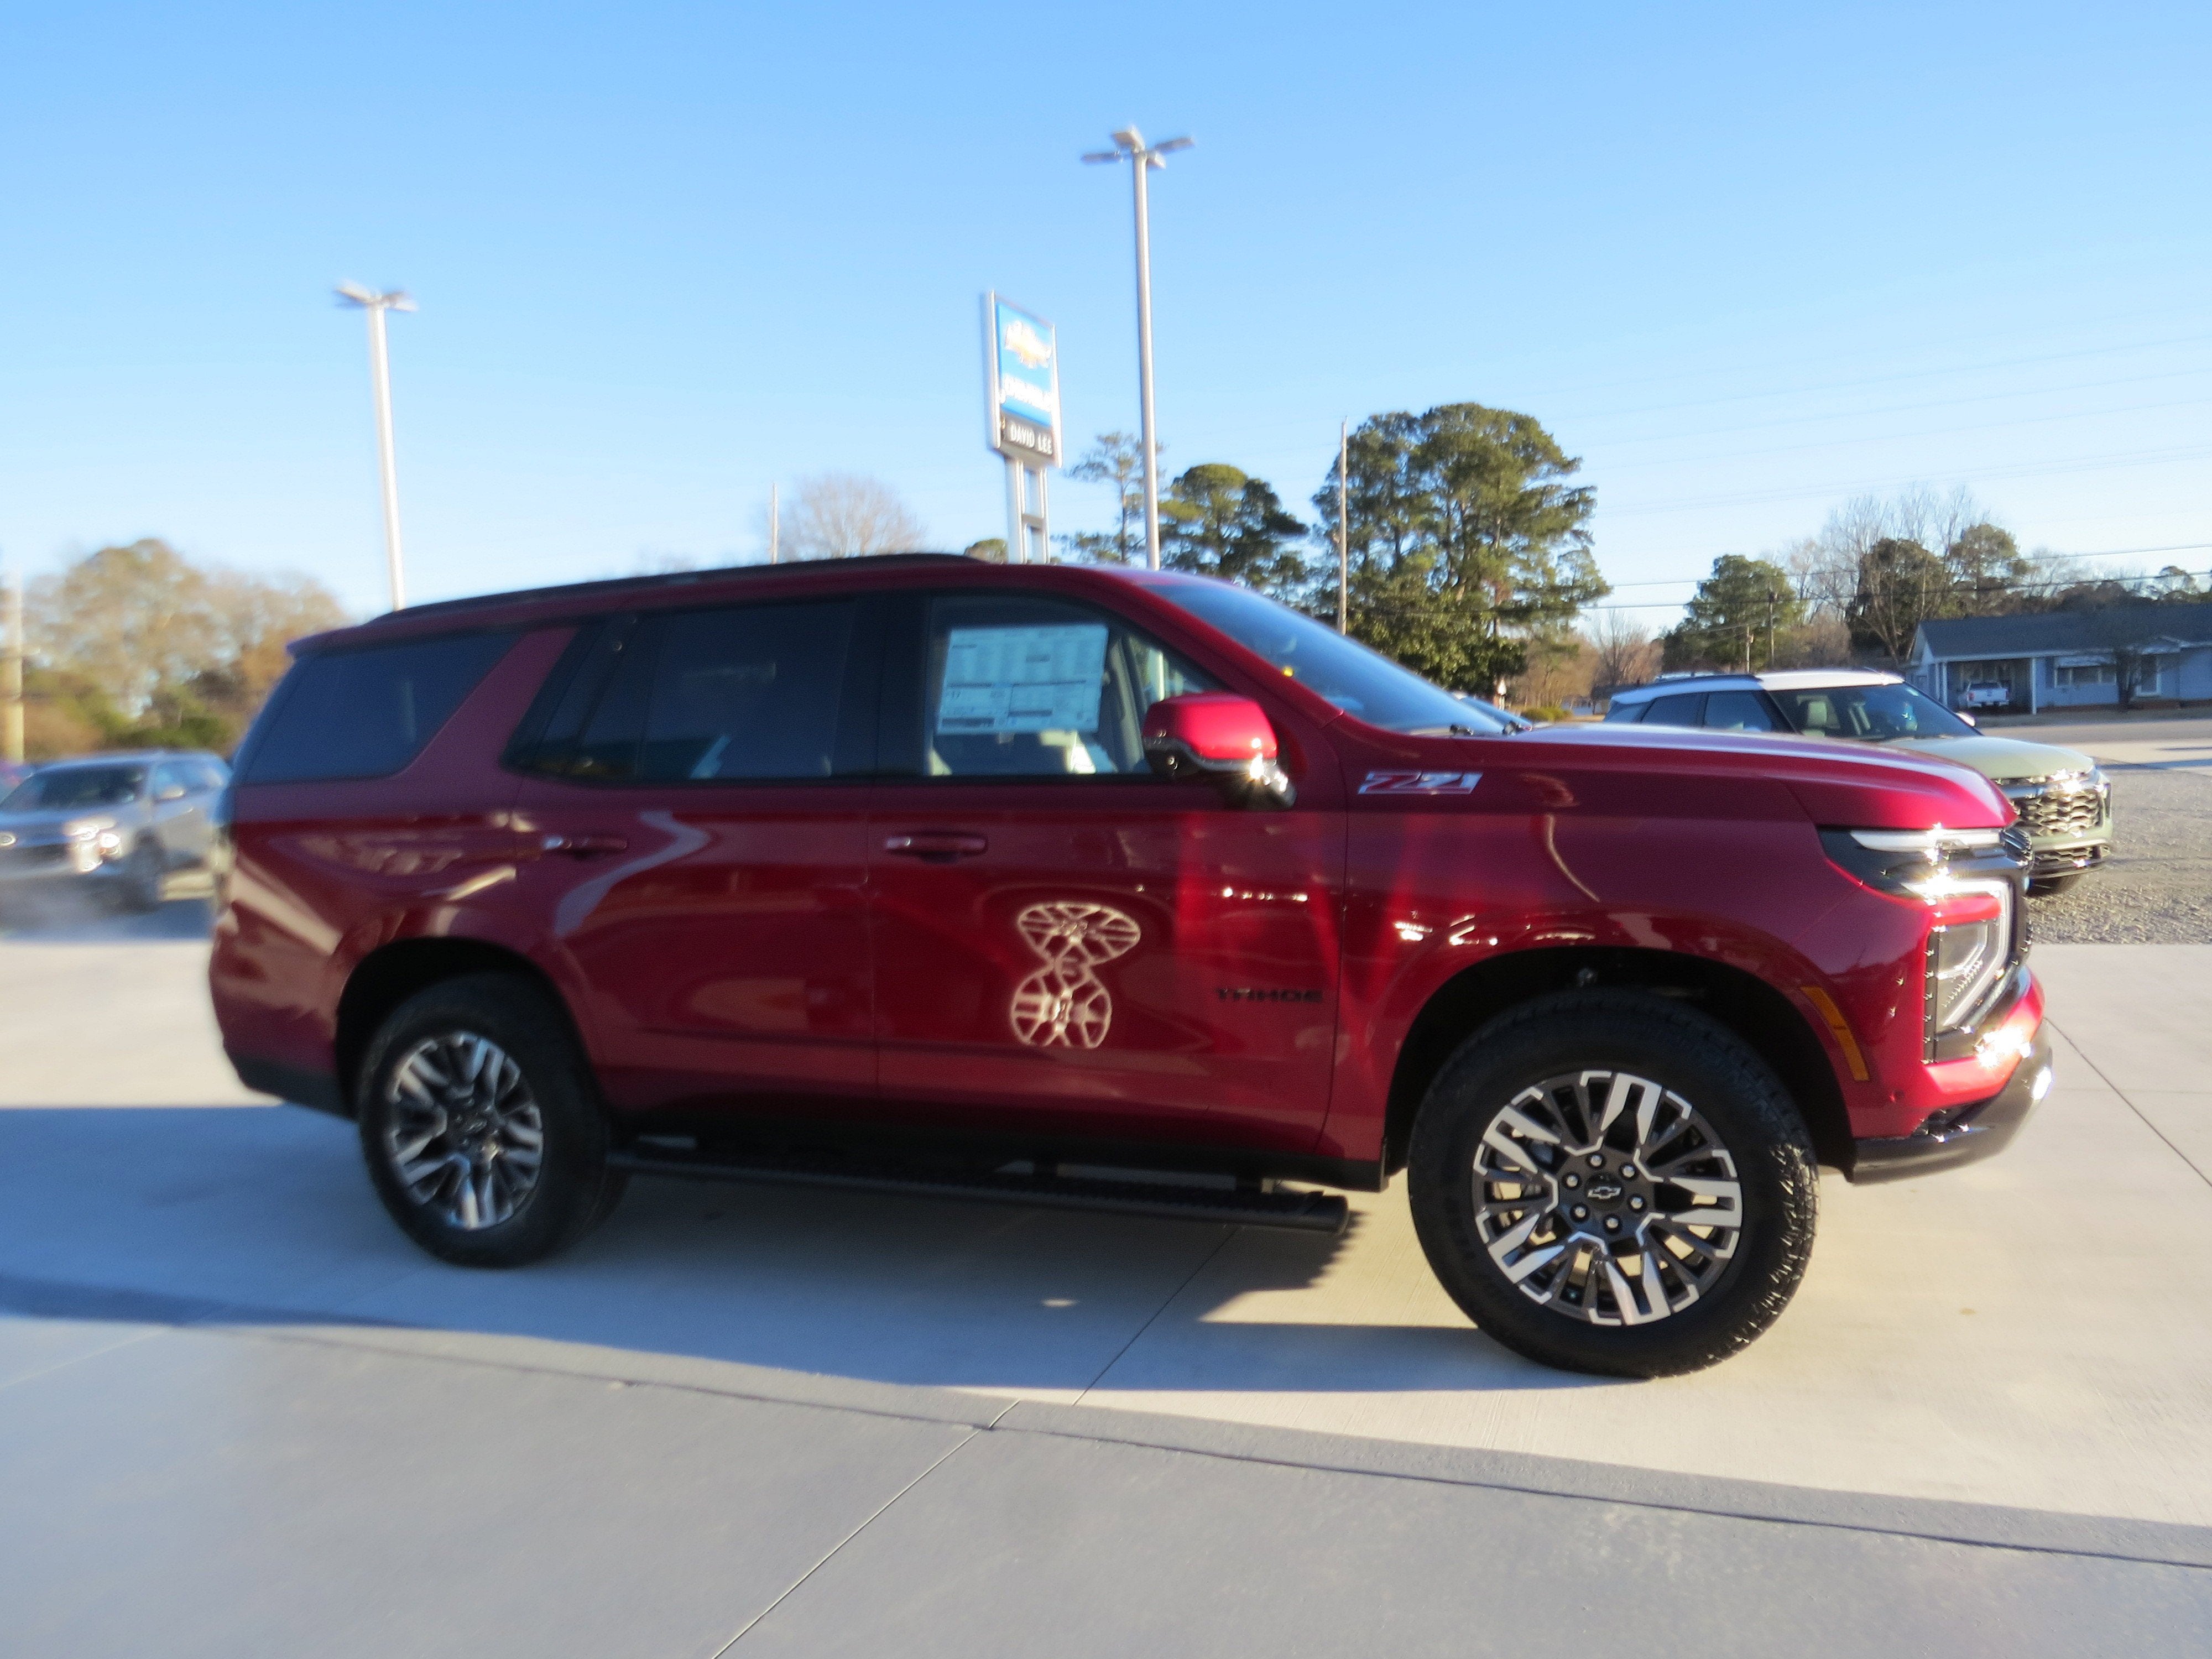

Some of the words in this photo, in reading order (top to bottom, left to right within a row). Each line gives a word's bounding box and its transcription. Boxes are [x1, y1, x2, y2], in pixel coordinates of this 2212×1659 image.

[1010, 422, 1035, 448] DAVID
[1037, 433, 1052, 455] LEE
[1357, 772, 1484, 795] Z71
[1215, 988, 1323, 1003] TAHOE
